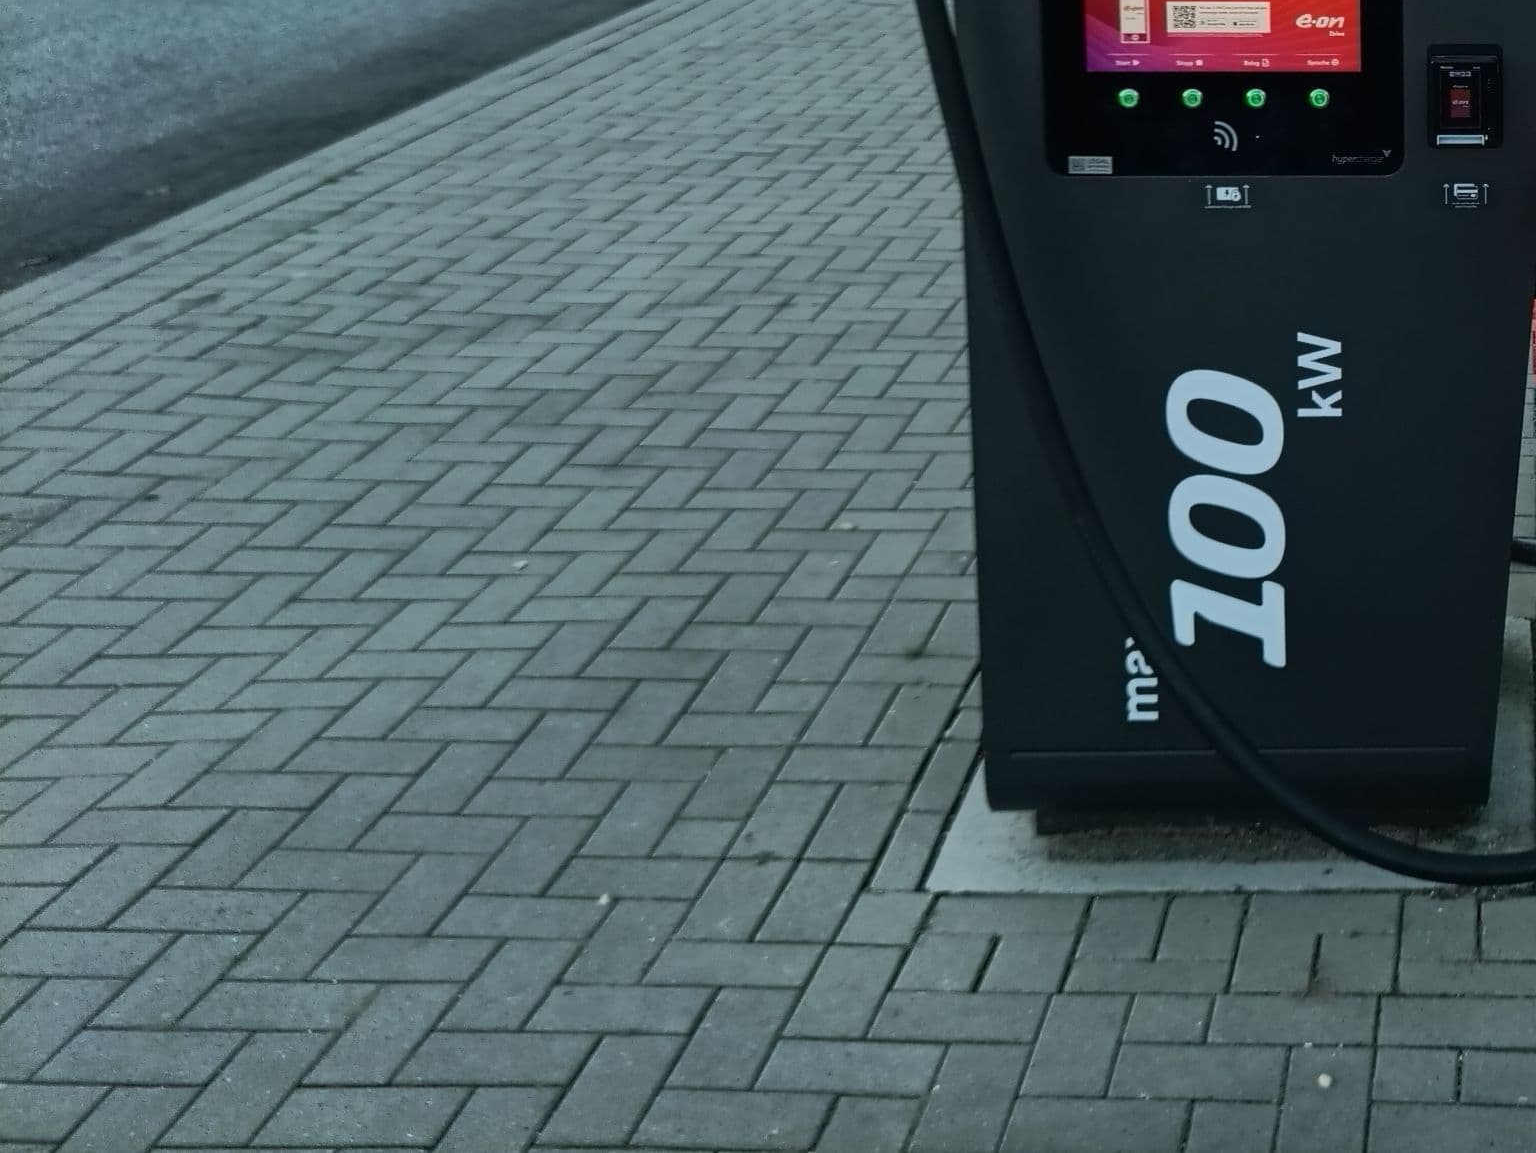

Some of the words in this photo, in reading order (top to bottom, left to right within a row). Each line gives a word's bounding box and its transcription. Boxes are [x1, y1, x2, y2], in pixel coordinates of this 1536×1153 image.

[1297, 332, 1343, 418] kW
[1165, 369, 1287, 668] 100
[1125, 636, 1159, 722] ma
